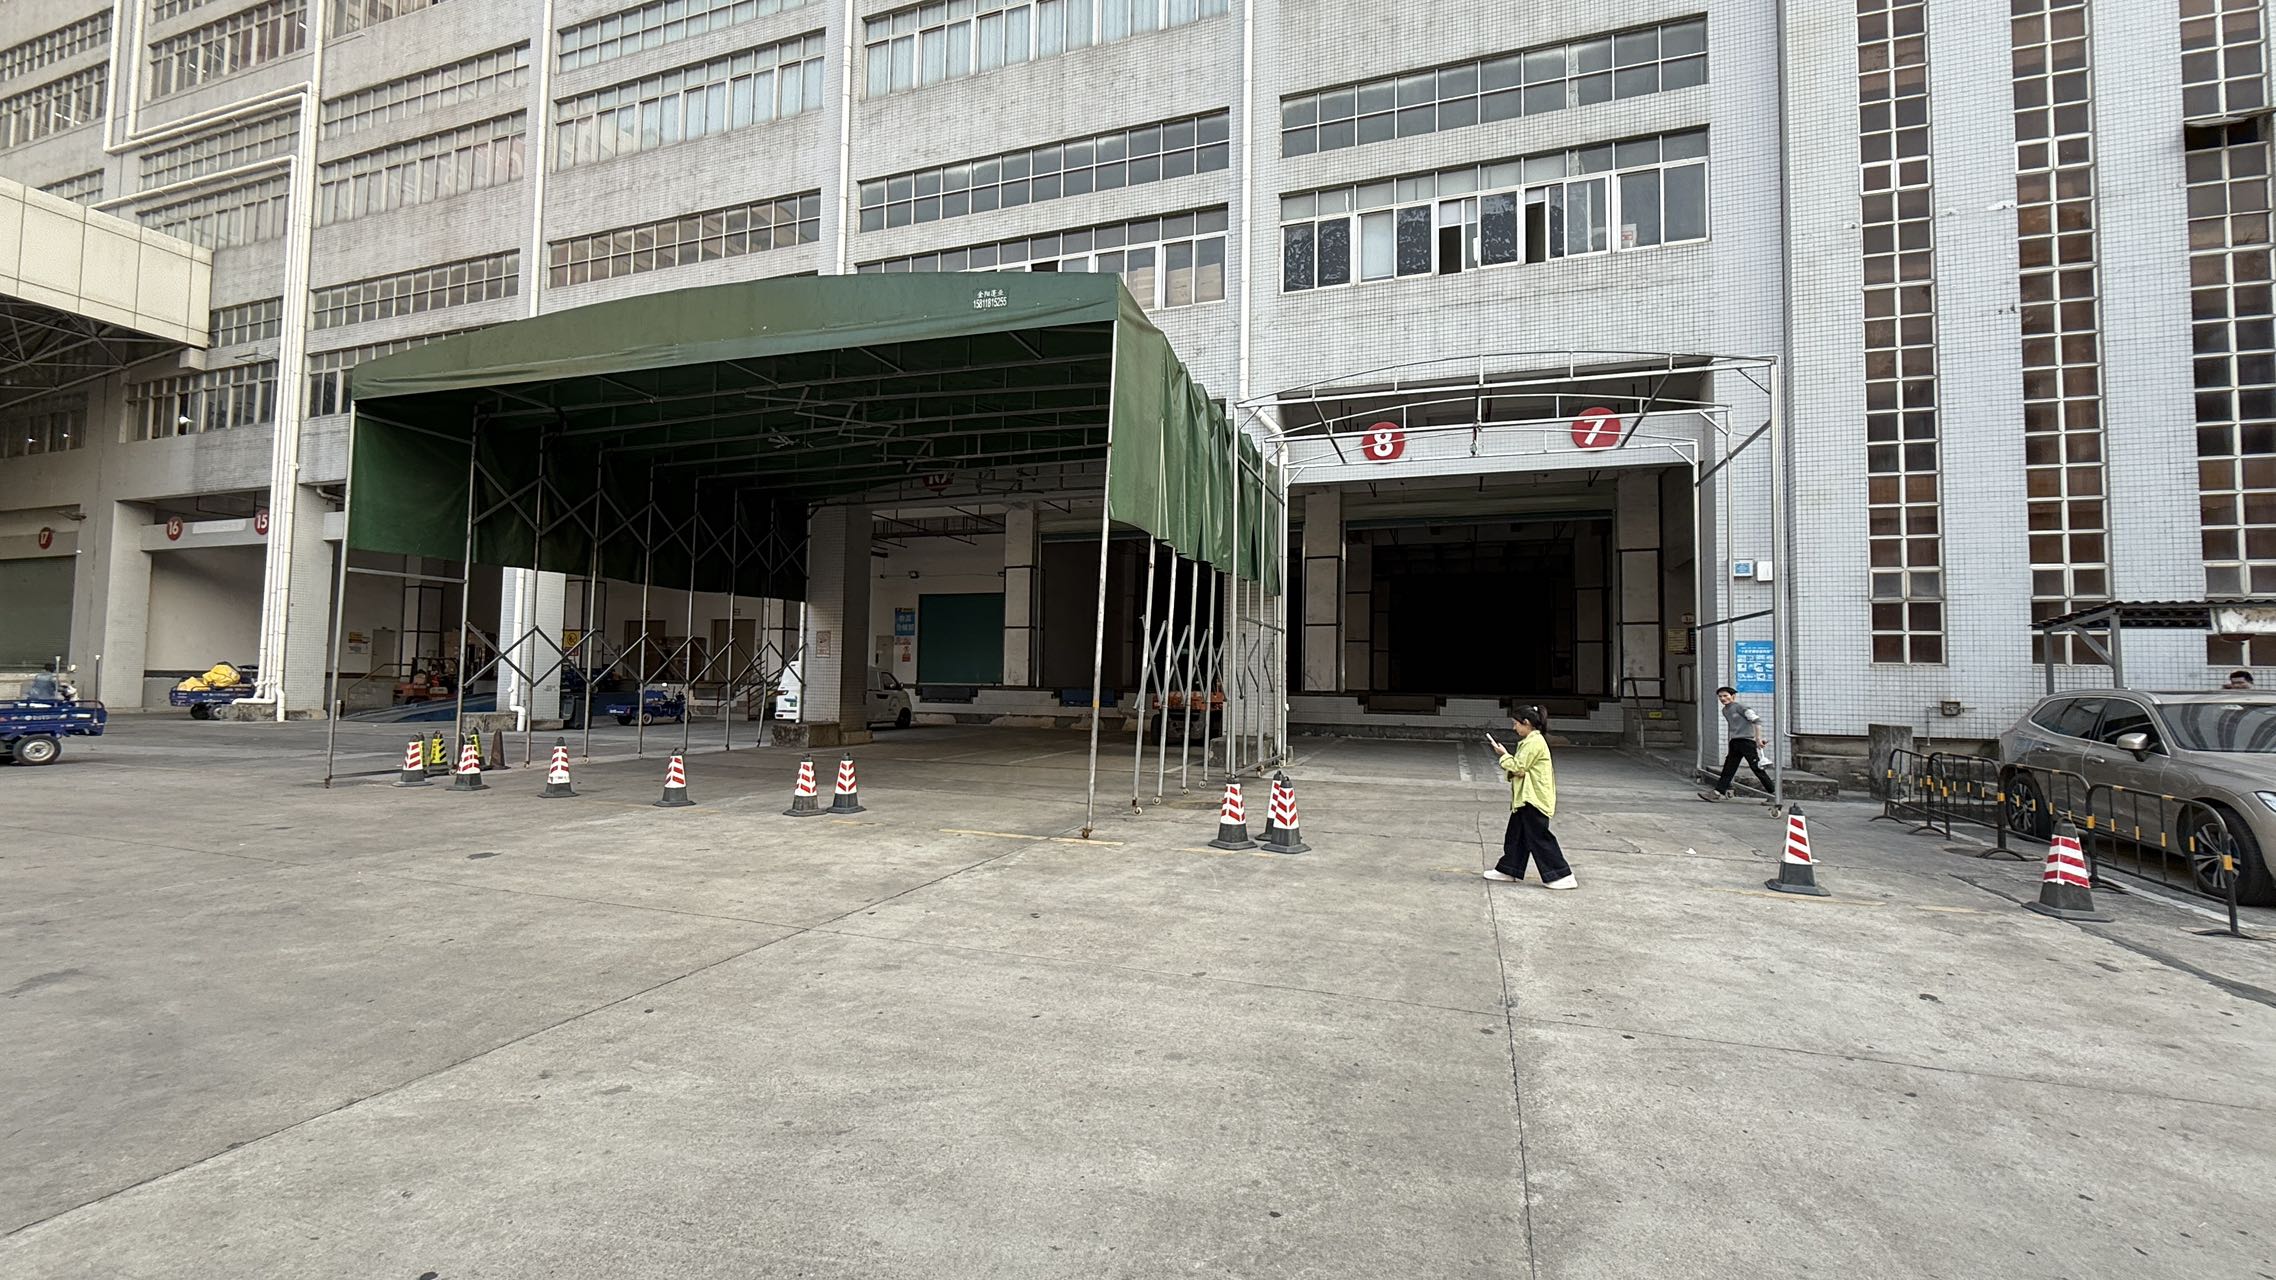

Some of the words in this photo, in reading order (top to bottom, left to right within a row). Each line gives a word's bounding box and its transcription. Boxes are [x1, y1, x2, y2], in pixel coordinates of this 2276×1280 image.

[1583, 419, 1607, 446] 7
[1373, 428, 1394, 457] 8
[168, 521, 179, 535] 16
[256, 514, 268, 529] 15
[40, 531, 50, 545] 17
